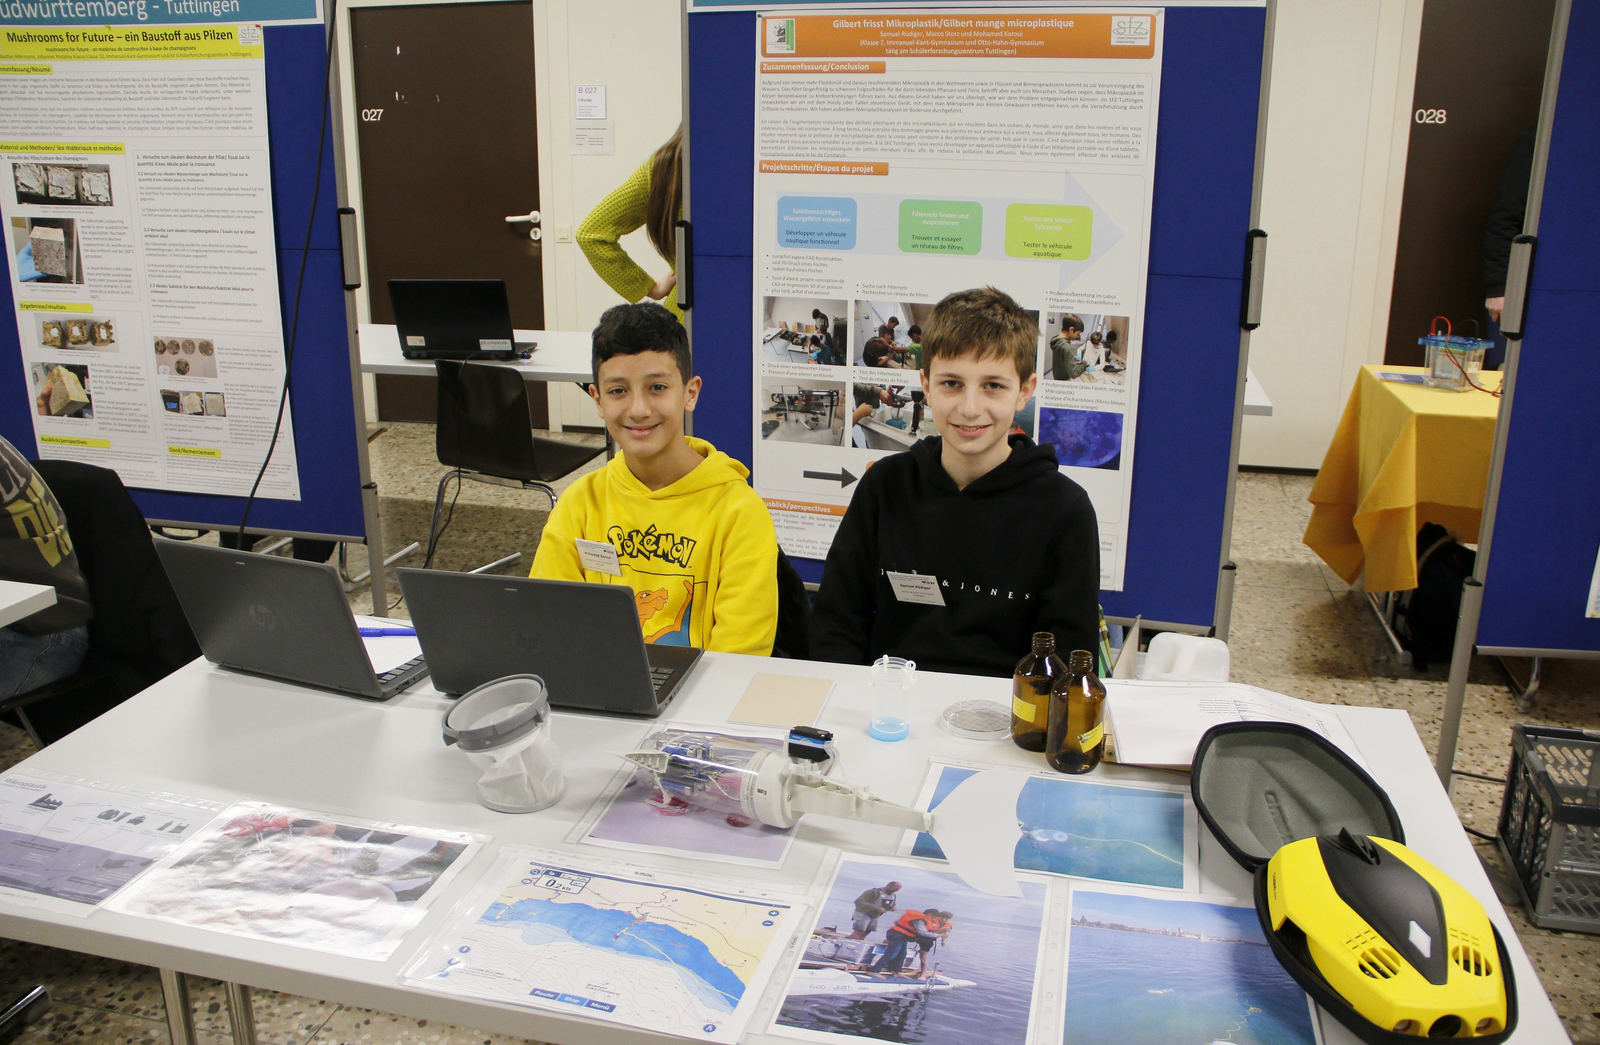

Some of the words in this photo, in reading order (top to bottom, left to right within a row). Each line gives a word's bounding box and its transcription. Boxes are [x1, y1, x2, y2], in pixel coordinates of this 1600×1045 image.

[164, 0, 239, 16] Tuttlingen
[833, 19, 861, 28] Gilbert
[864, 19, 884, 28] frisst
[886, 19, 973, 29] Mikroplastik/Gilbert
[976, 20, 1005, 28] mange
[1007, 19, 1074, 29] microplastique
[7, 32, 63, 42] Mushrooms
[66, 32, 79, 42] for
[83, 33, 114, 42] Future
[125, 32, 139, 41] ein
[142, 30, 181, 41] Baustoff
[184, 32, 201, 40] aus
[203, 30, 233, 40] Pilzen
[763, 63, 869, 71] Zusammenfassung/Conclusion
[362, 109, 384, 121] 027
[1415, 110, 1447, 124] 028
[762, 163, 839, 172] Projektschritte/Étapes
[852, 165, 874, 173] projet
[764, 501, 830, 512] usblick/perspectives
[534, 990, 554, 998] Route
[590, 1002, 610, 1011] Menü
